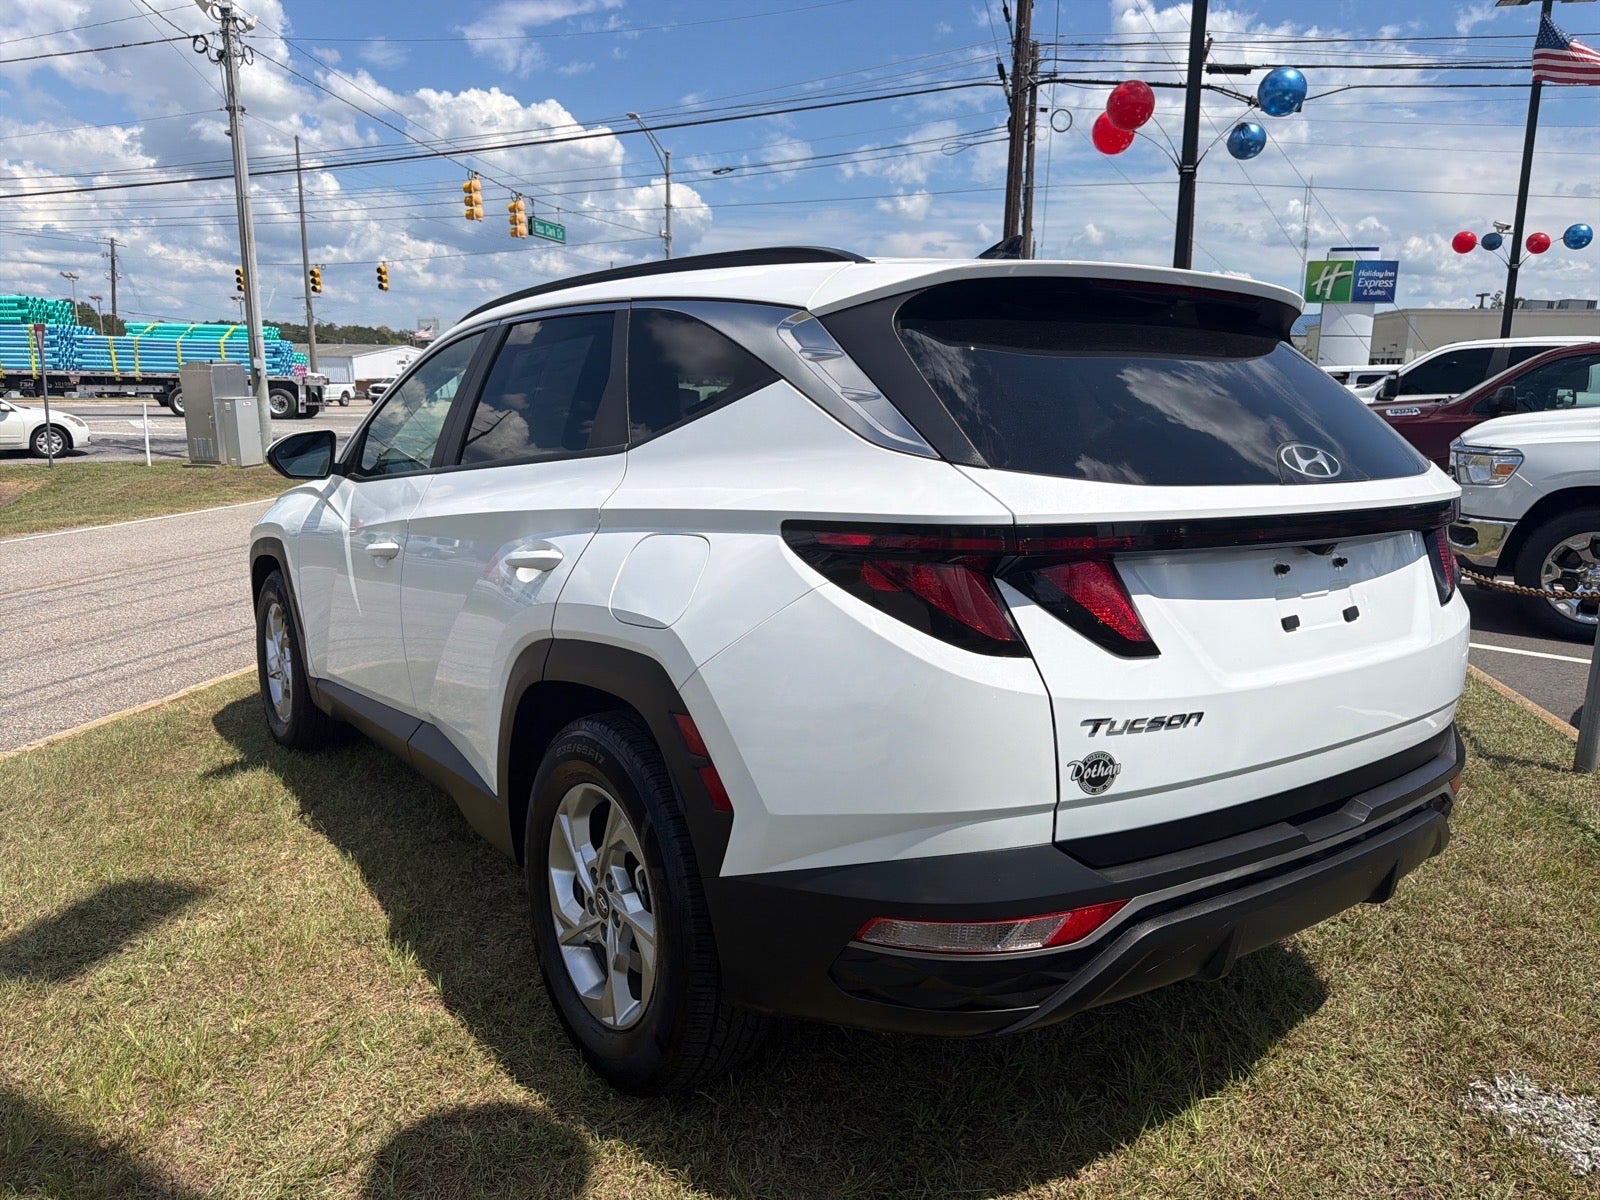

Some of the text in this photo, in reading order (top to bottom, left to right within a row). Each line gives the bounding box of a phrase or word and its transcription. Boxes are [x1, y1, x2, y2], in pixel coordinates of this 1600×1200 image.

[1358, 269, 1395, 279] Holiday Inn
[1357, 278, 1394, 290] Express
[555, 743, 605, 764] 235/65R17
[1066, 759, 1122, 782] Dothan
